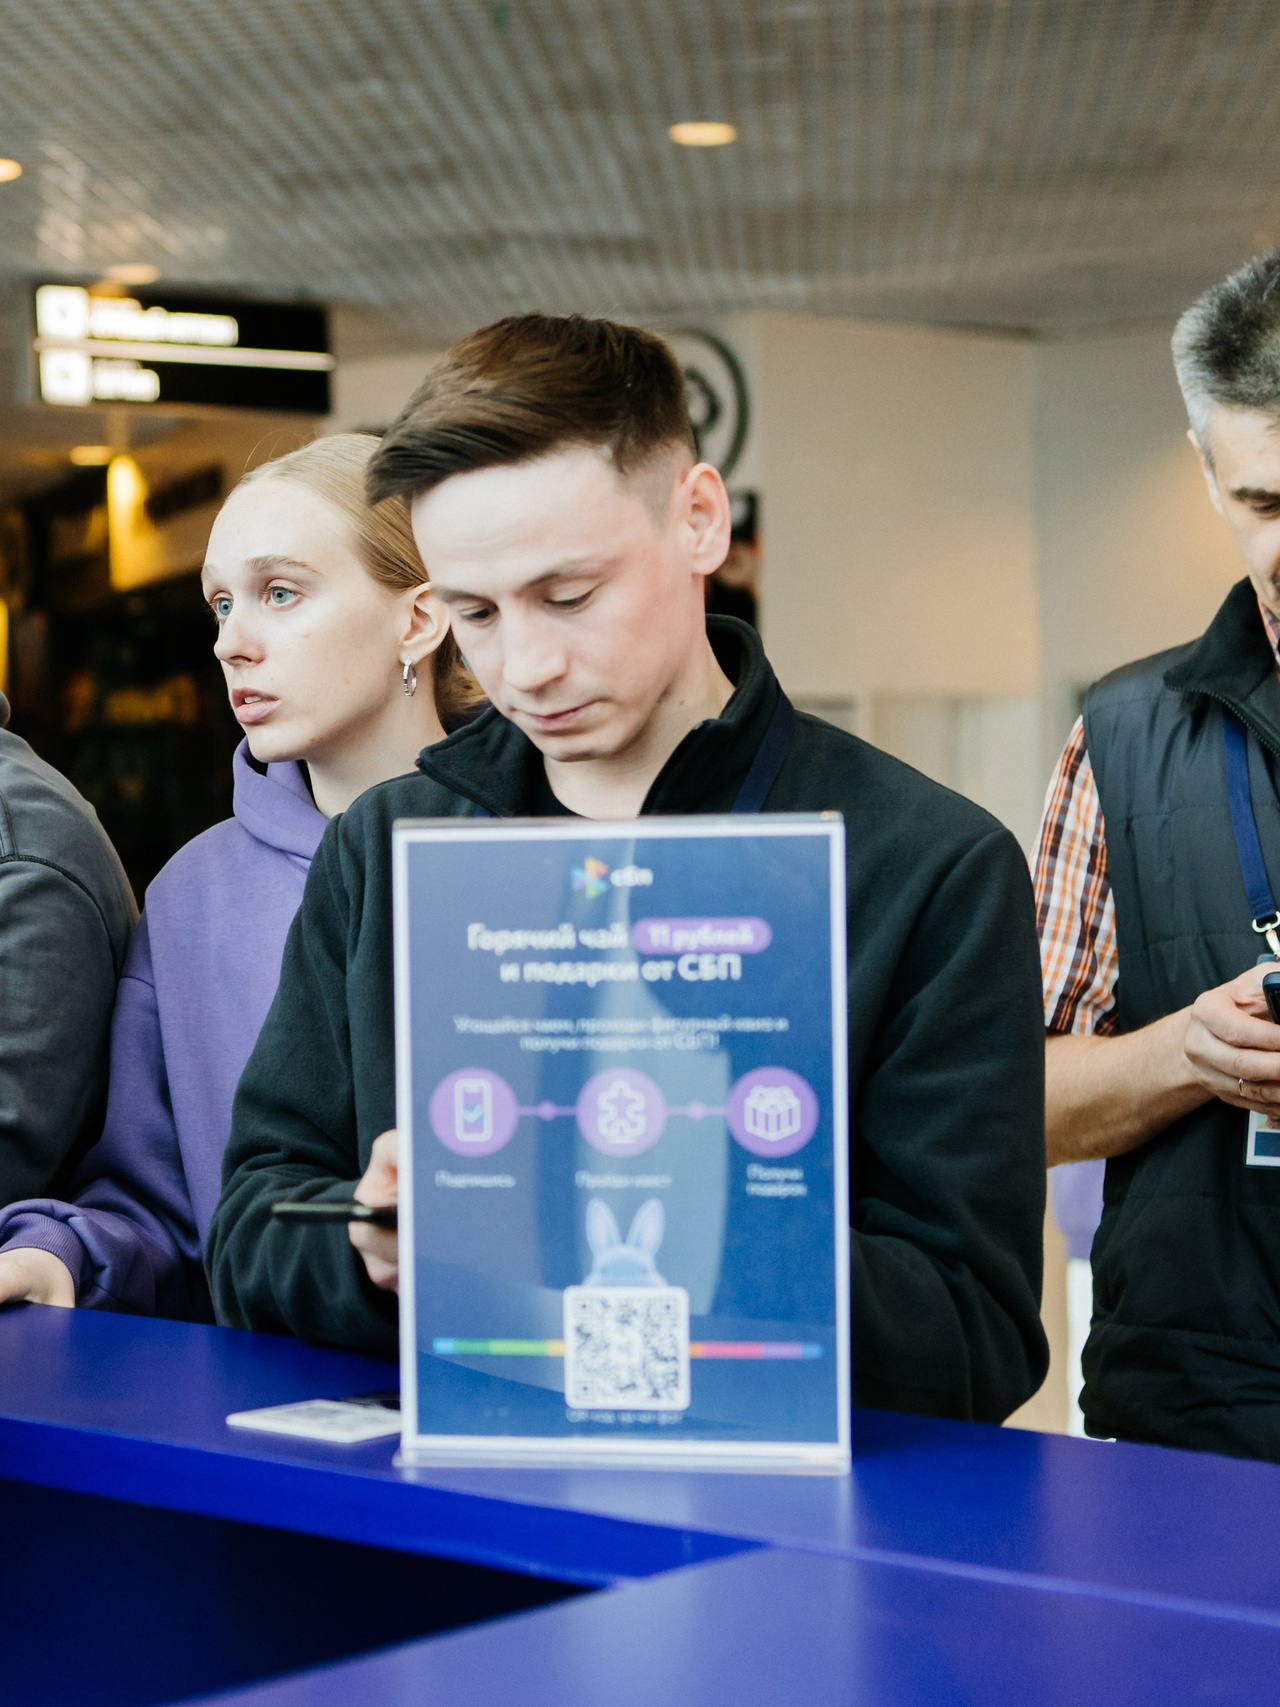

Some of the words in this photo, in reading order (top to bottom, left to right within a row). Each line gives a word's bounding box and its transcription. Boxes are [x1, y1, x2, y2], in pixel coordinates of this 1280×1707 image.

[467, 922, 577, 956] Горячий
[578, 922, 629, 950] чай
[648, 923, 671, 947] 11
[672, 923, 754, 951] рублей
[500, 962, 520, 982] и
[522, 961, 639, 987] подарки
[641, 960, 676, 981] от
[677, 953, 742, 981] СБП
